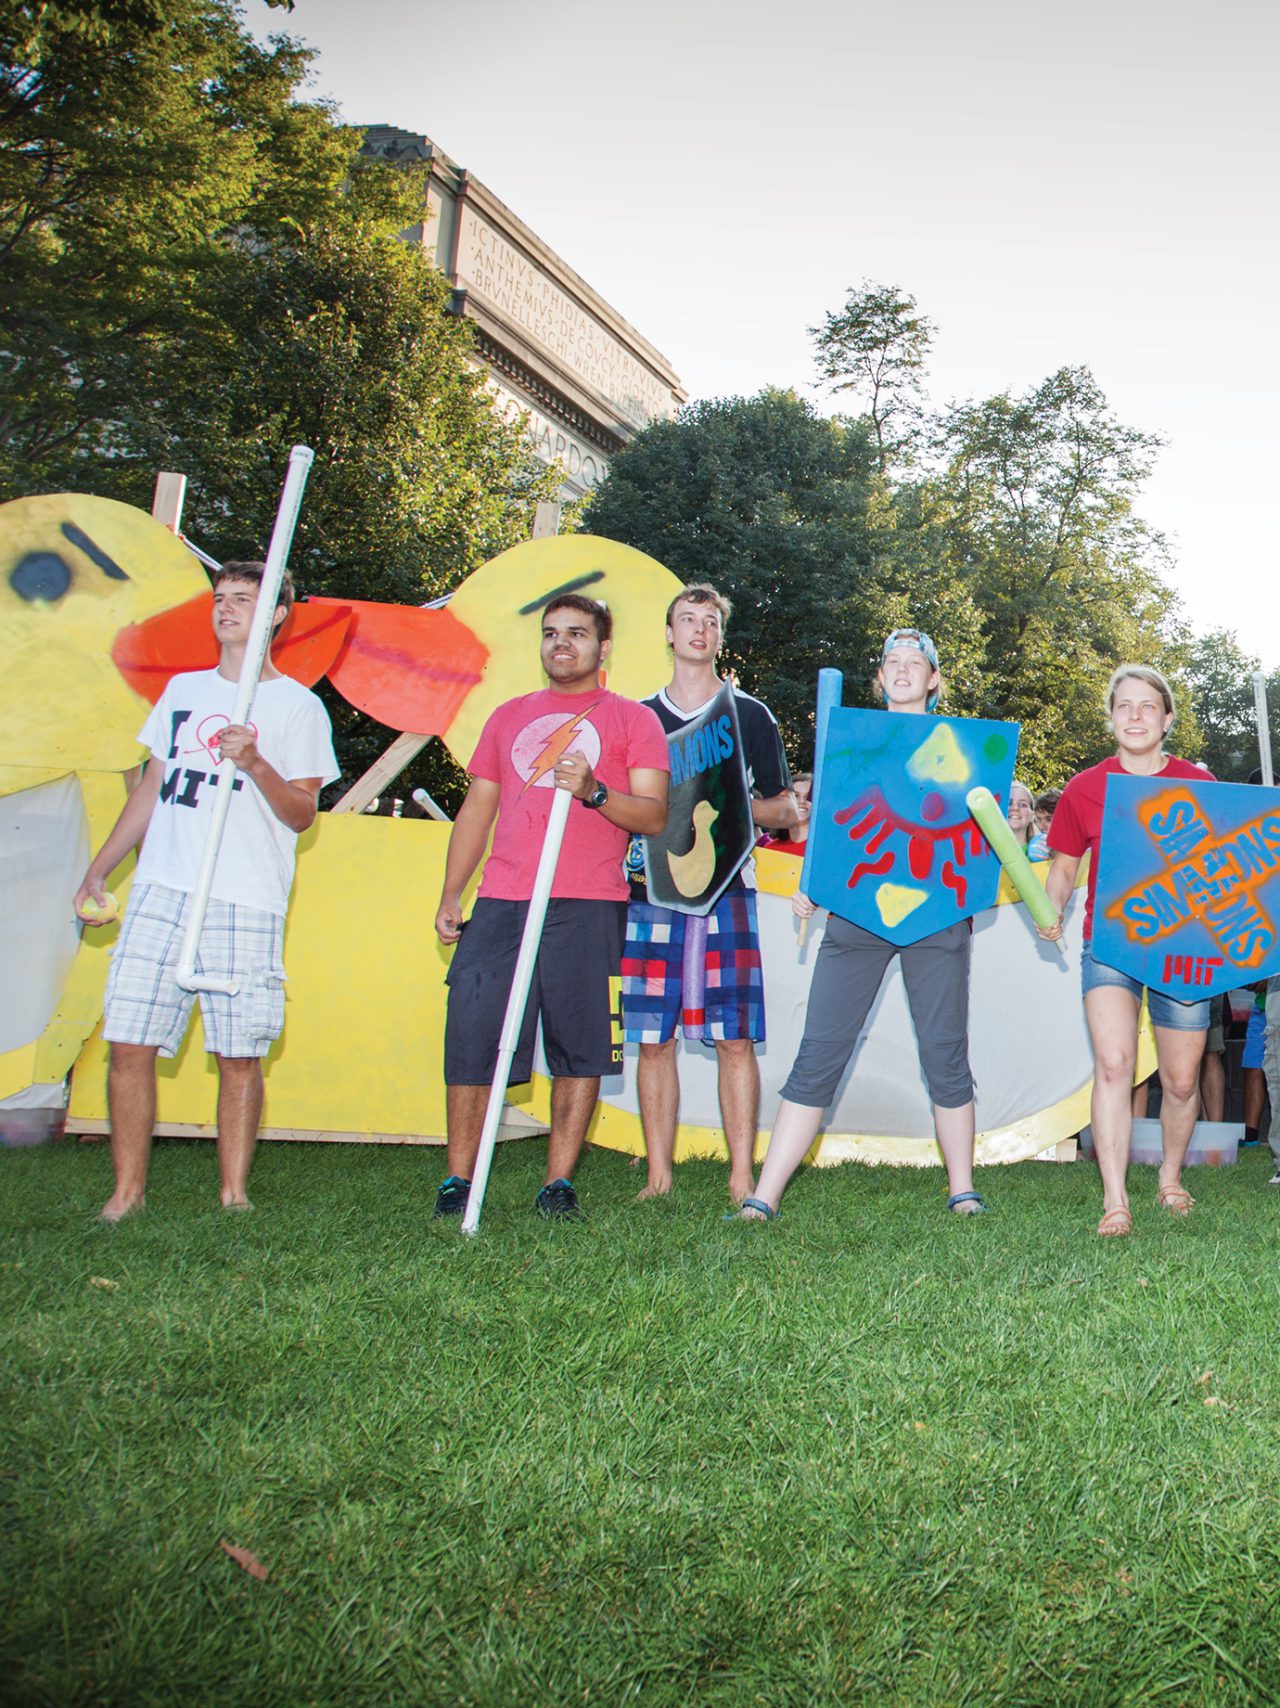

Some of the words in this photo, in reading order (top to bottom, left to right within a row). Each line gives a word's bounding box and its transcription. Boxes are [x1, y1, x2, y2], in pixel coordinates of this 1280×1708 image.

[474, 249, 553, 326] ANTHEMIVS
[560, 320, 575, 344] DE
[475, 268, 568, 359] BRVNELLESCHI
[574, 351, 605, 388] WREN
[542, 283, 594, 341] PHIDIAS
[168, 710, 193, 759] I
[669, 714, 735, 786] MONS
[1162, 954, 1224, 986] MIT
